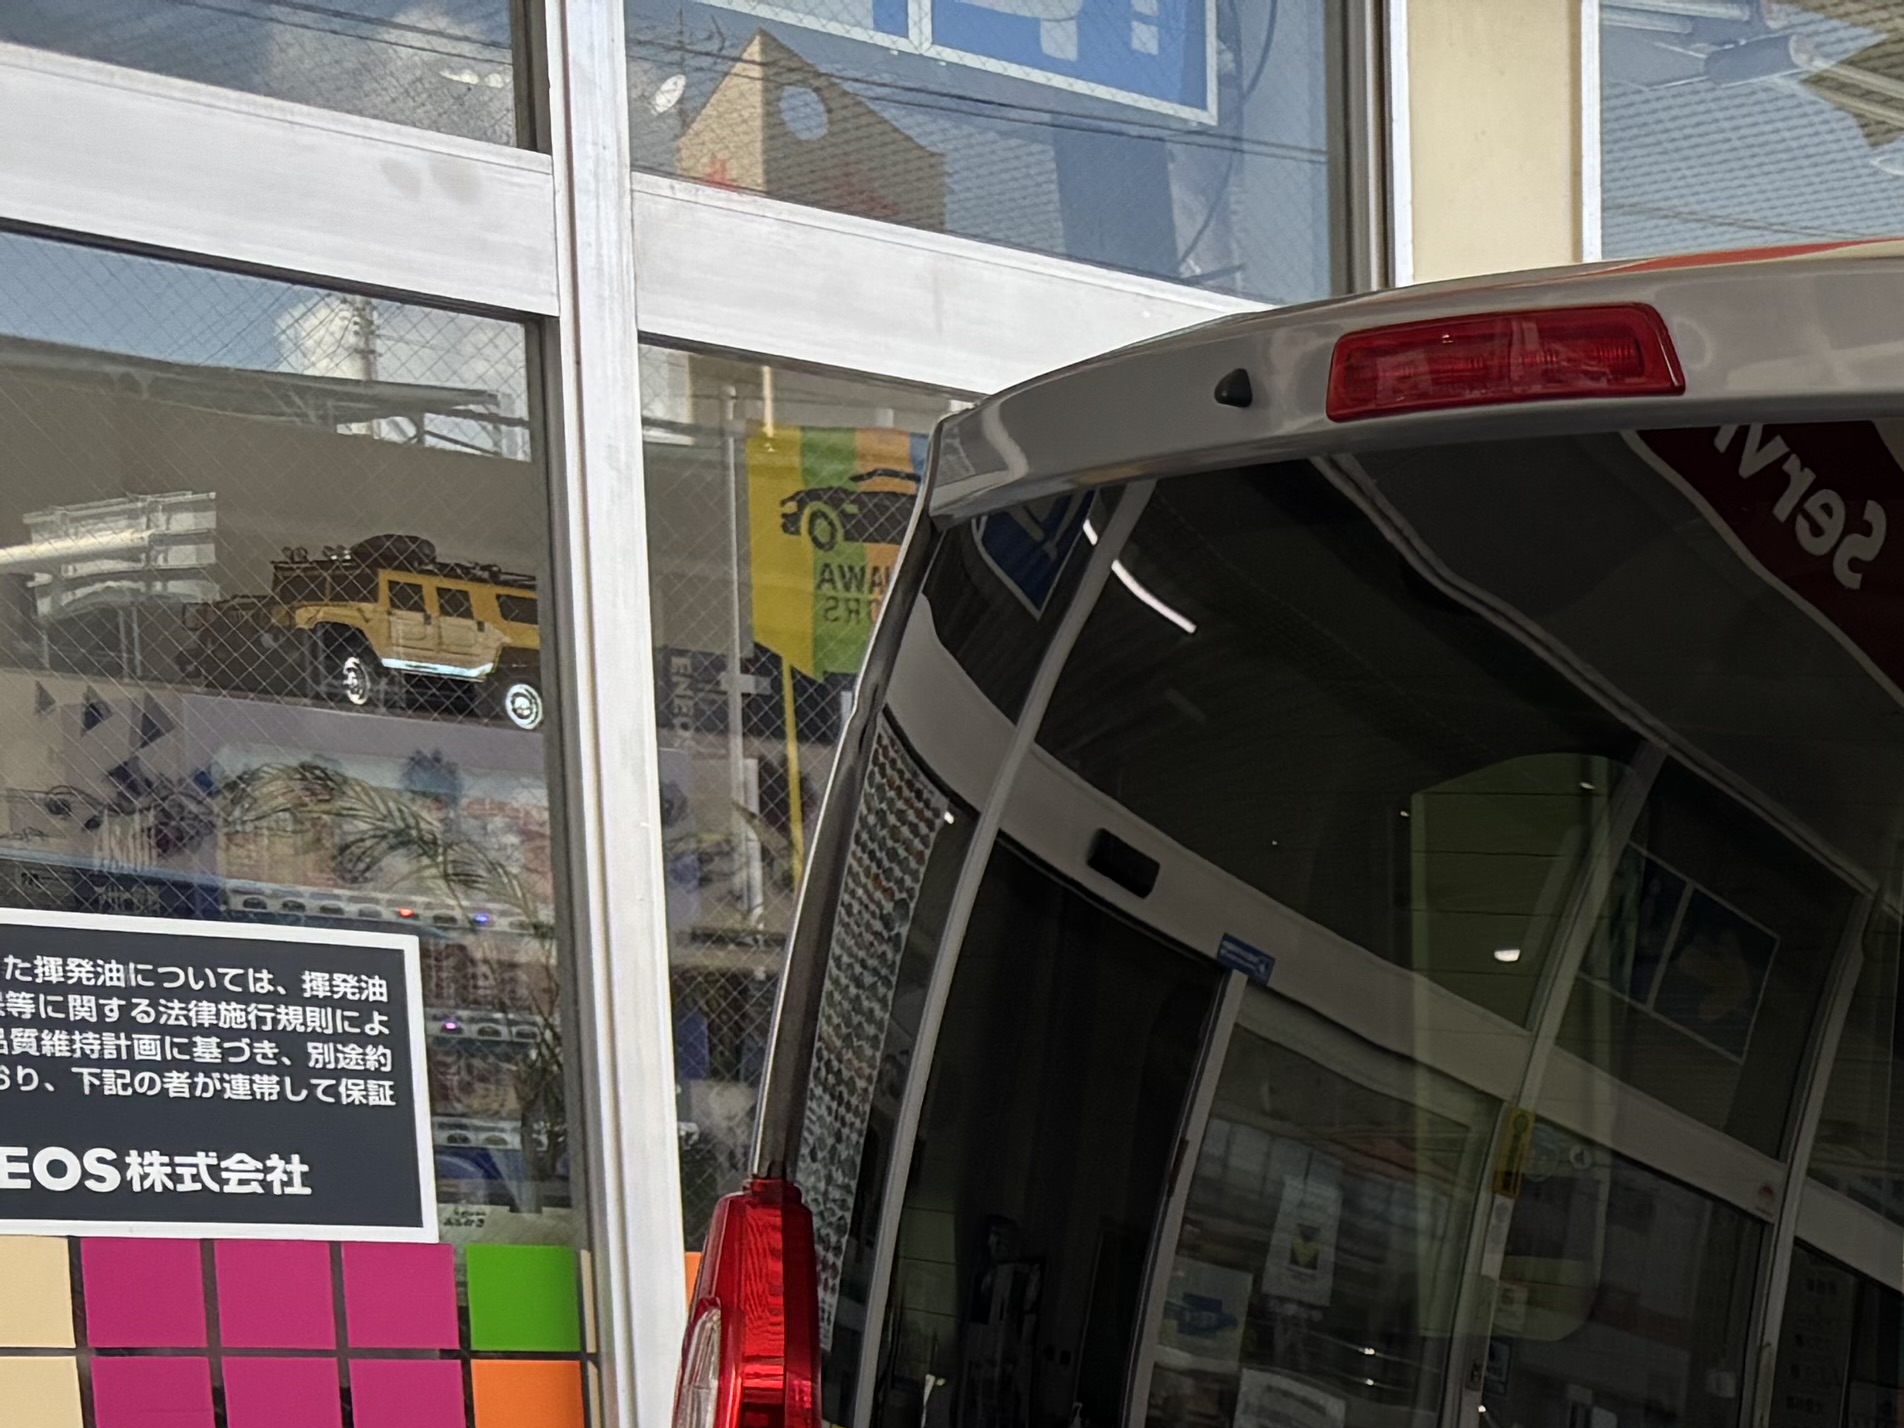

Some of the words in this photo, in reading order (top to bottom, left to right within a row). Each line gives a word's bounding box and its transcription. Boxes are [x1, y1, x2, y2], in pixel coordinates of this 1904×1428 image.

[3, 953, 389, 1003] た揮発油については、揮発油
[0, 990, 390, 1037] 等に関する法律施行規則によ
